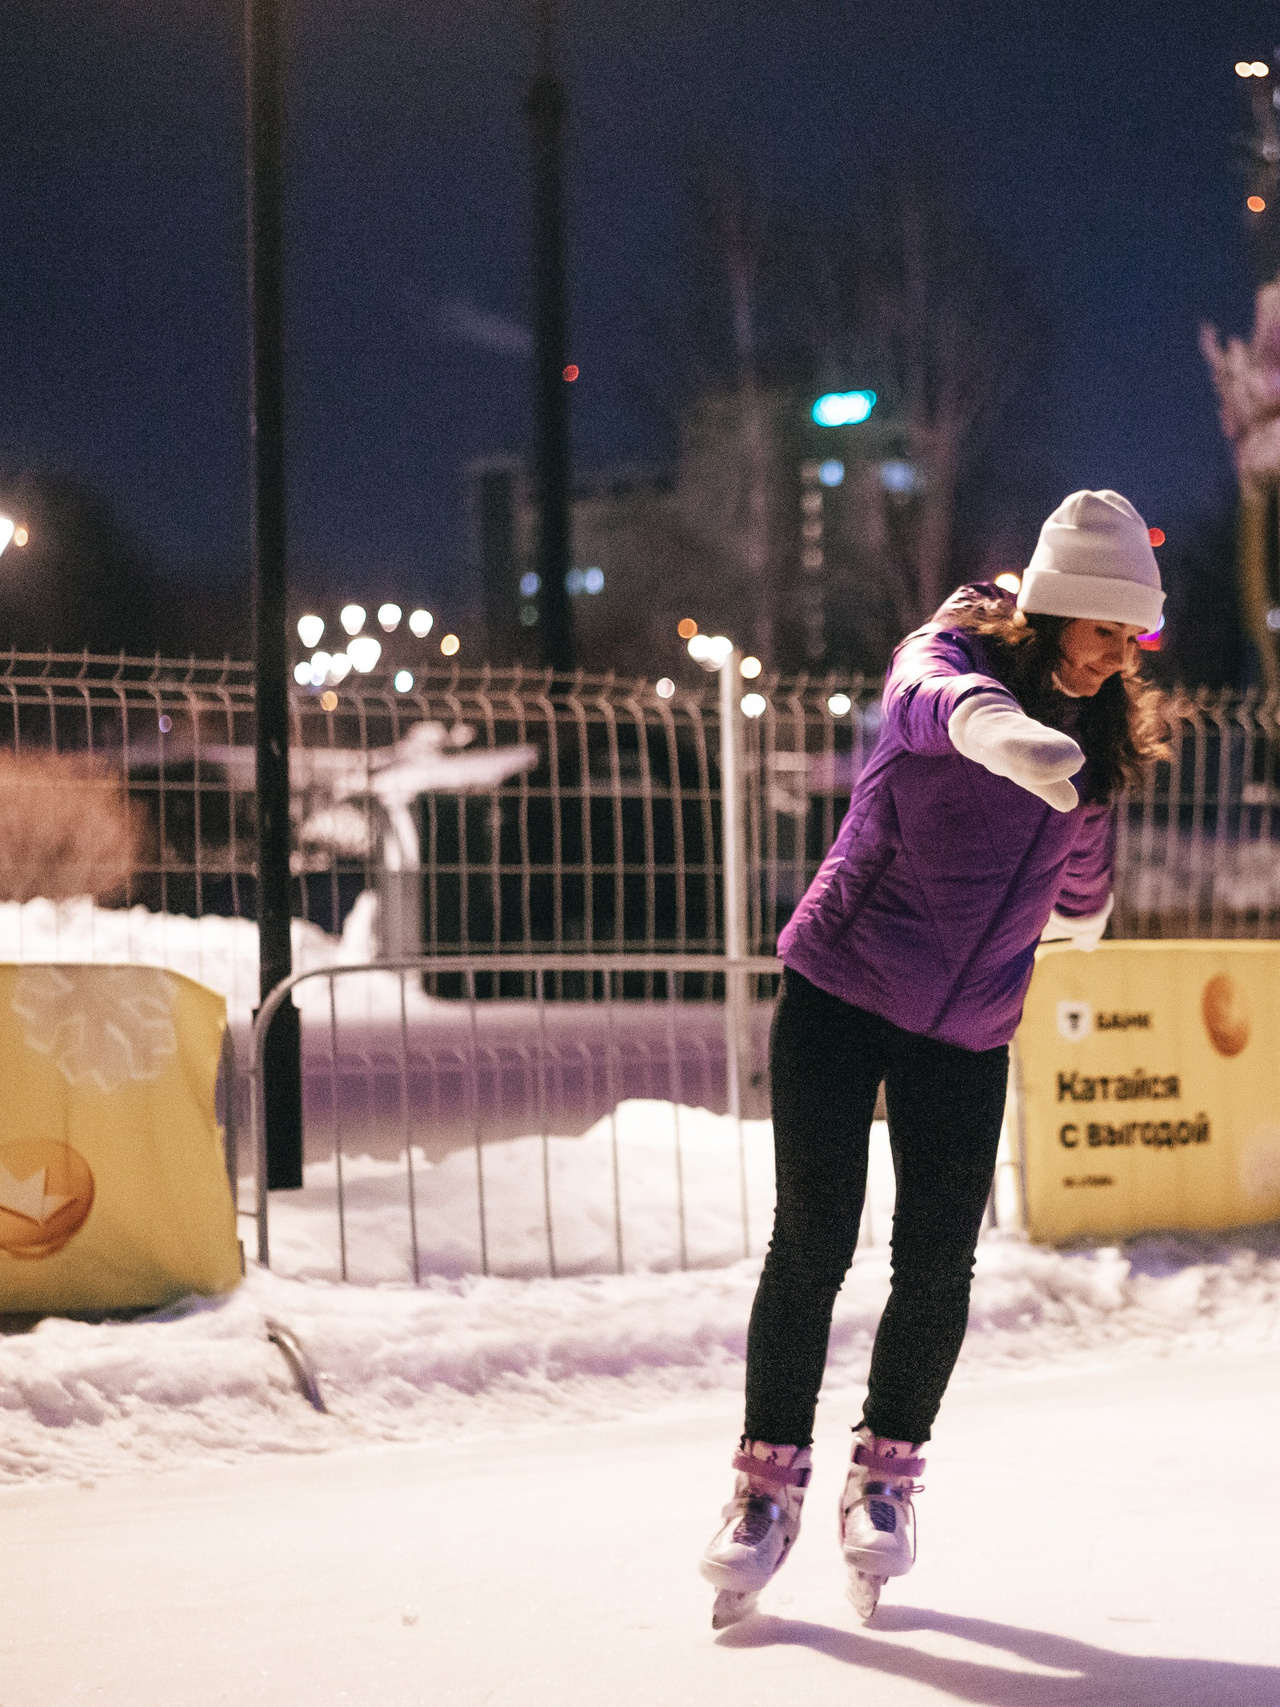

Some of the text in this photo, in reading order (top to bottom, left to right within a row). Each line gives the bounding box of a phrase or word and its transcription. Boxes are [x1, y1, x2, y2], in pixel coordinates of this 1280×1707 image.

[1057, 1068, 1180, 1102] Катайся
[1060, 1112, 1210, 1151] с выгодой
